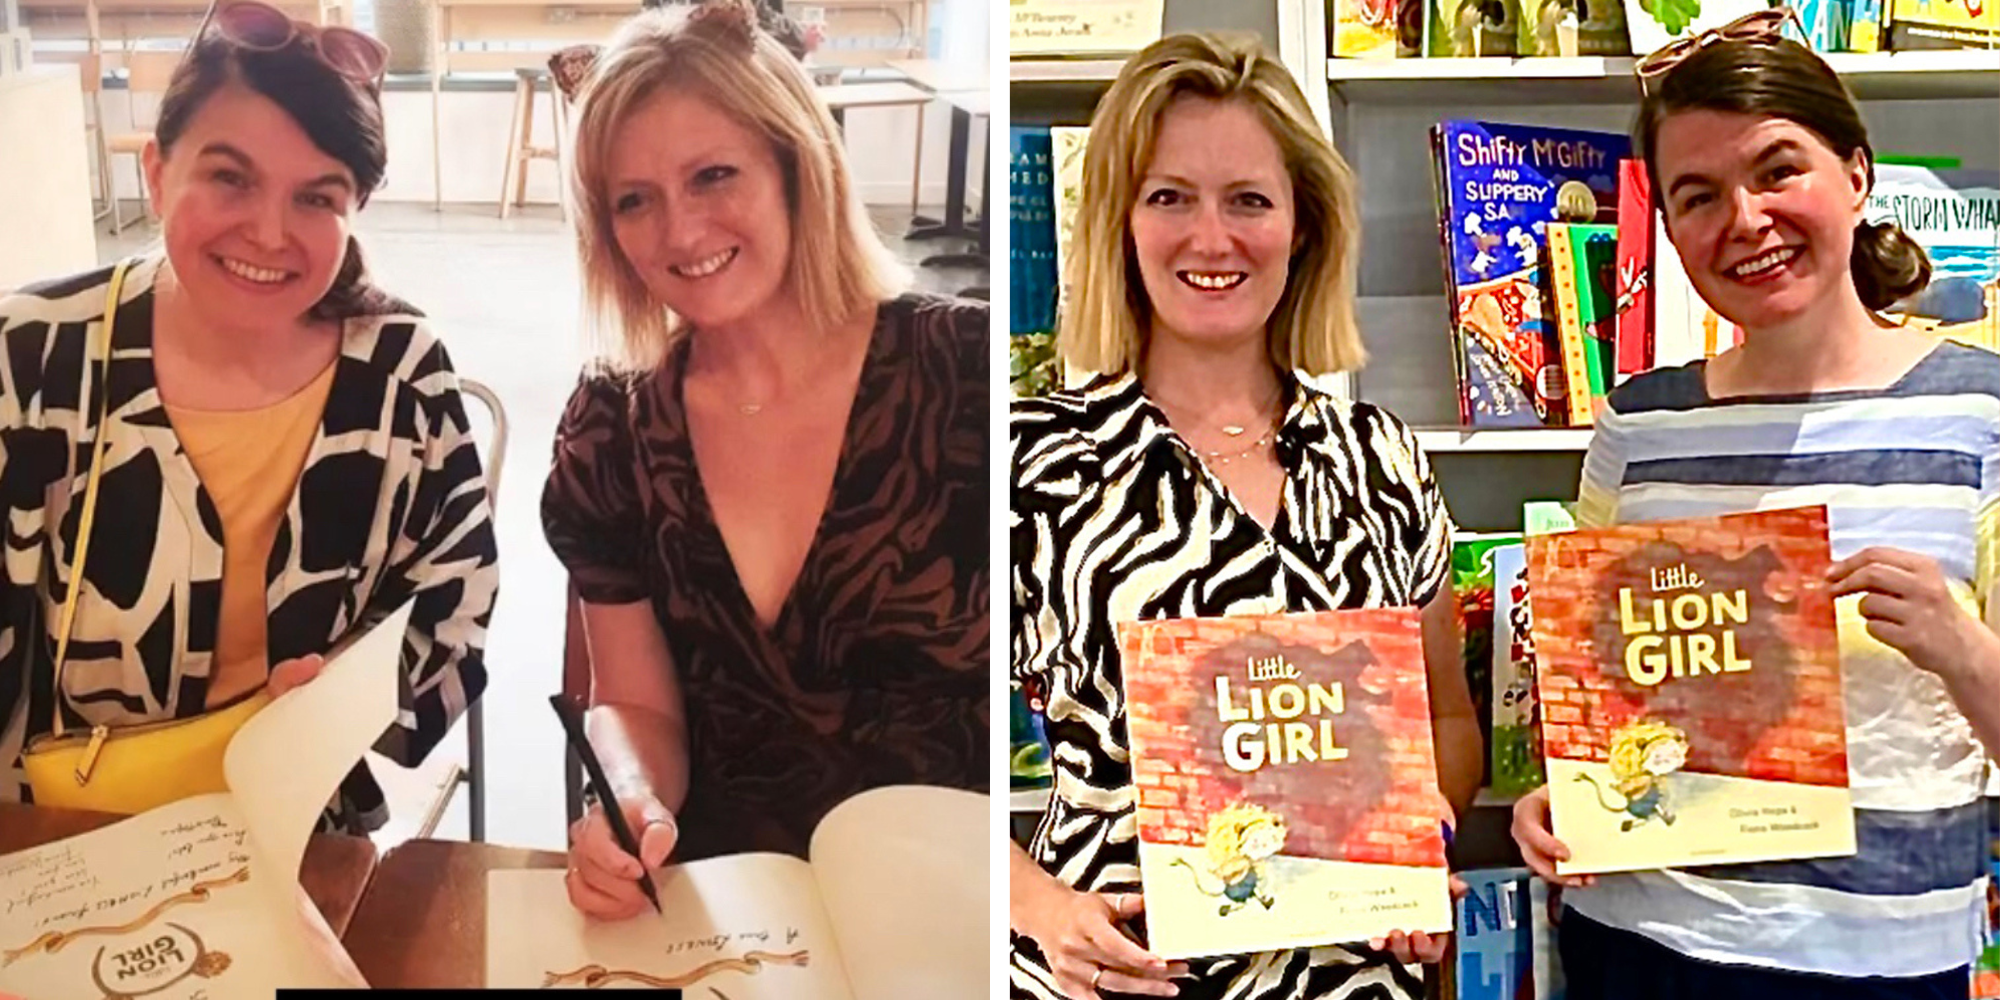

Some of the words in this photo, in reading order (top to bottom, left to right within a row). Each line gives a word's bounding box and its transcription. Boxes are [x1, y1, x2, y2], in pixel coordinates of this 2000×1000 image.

[1492, 168, 1520, 182] AND
[1465, 180, 1549, 203] SLIPPERY
[1484, 202, 1516, 222] SA
[1869, 195, 1890, 208] THE
[1893, 194, 1949, 232] STORM
[1651, 563, 1705, 592] Little
[1618, 587, 1749, 635] LION
[1248, 655, 1302, 681] Little
[1625, 630, 1752, 686] GIRL
[1215, 676, 1345, 722] LION
[1222, 719, 1349, 772] GIRL
[111, 935, 176, 966] GIRL
[117, 948, 185, 980] LION
